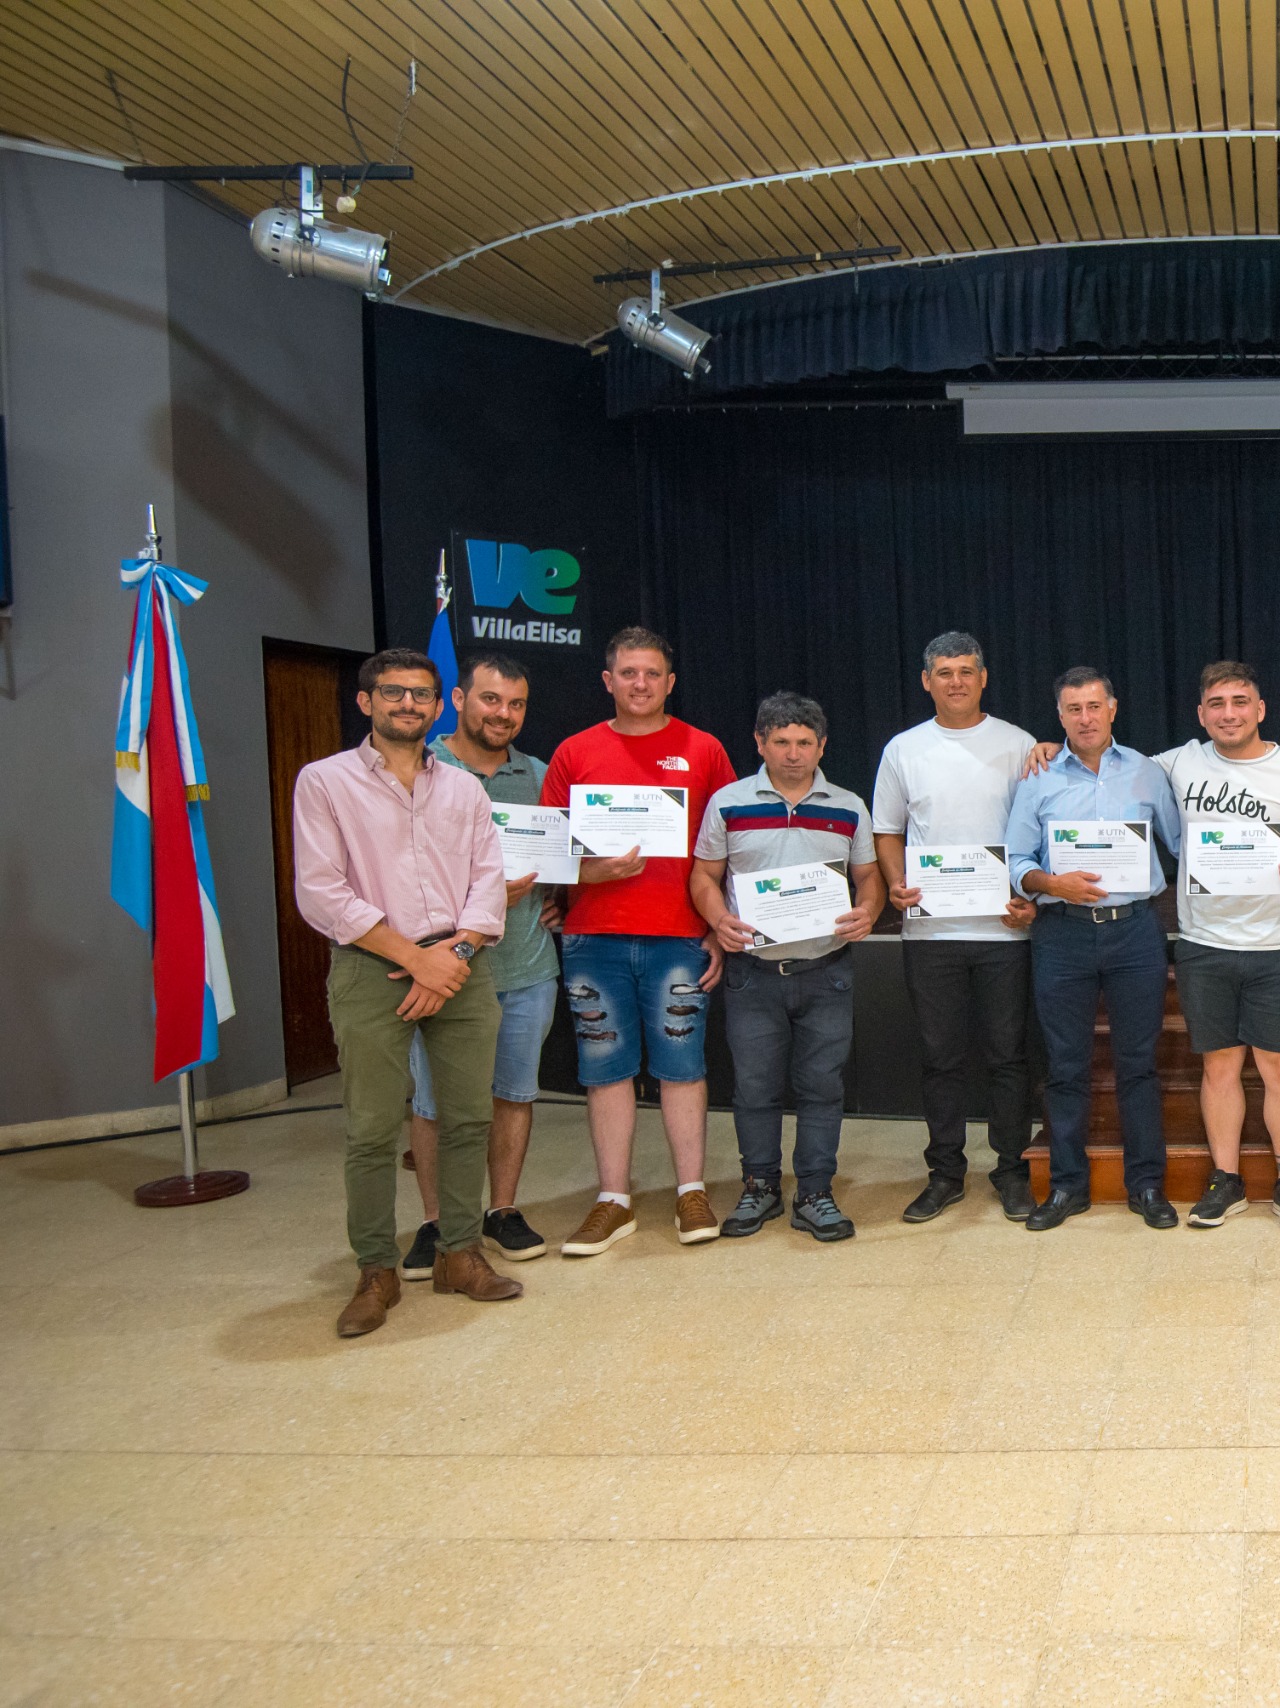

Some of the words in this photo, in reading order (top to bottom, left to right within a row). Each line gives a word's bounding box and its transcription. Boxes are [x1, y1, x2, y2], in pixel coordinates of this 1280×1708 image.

[472, 616, 581, 645] VillaElisa
[1183, 780, 1271, 822] Holster
[807, 870, 828, 879] UTN
